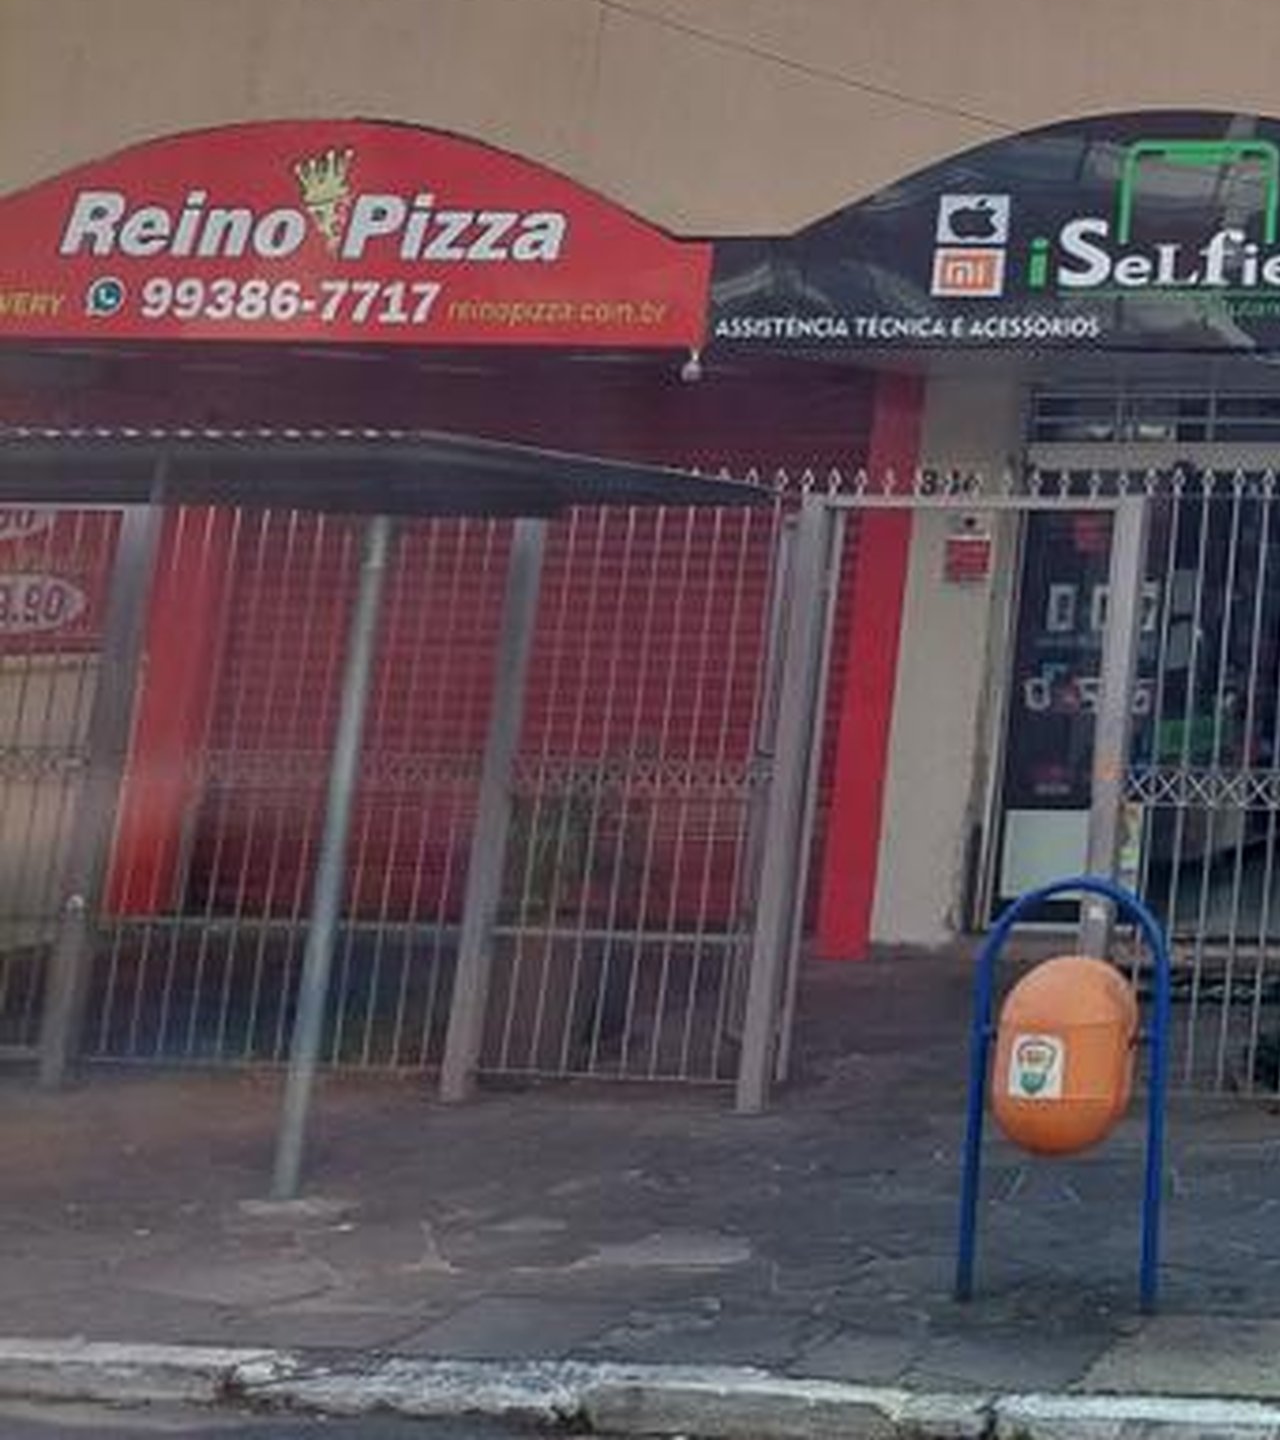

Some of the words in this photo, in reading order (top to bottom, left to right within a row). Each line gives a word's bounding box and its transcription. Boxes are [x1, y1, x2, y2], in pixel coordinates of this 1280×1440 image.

[60, 191, 307, 258] Reino
[342, 192, 567, 262] Pizza
[142, 277, 441, 325] 99386-7717
[950, 315, 965, 337] E
